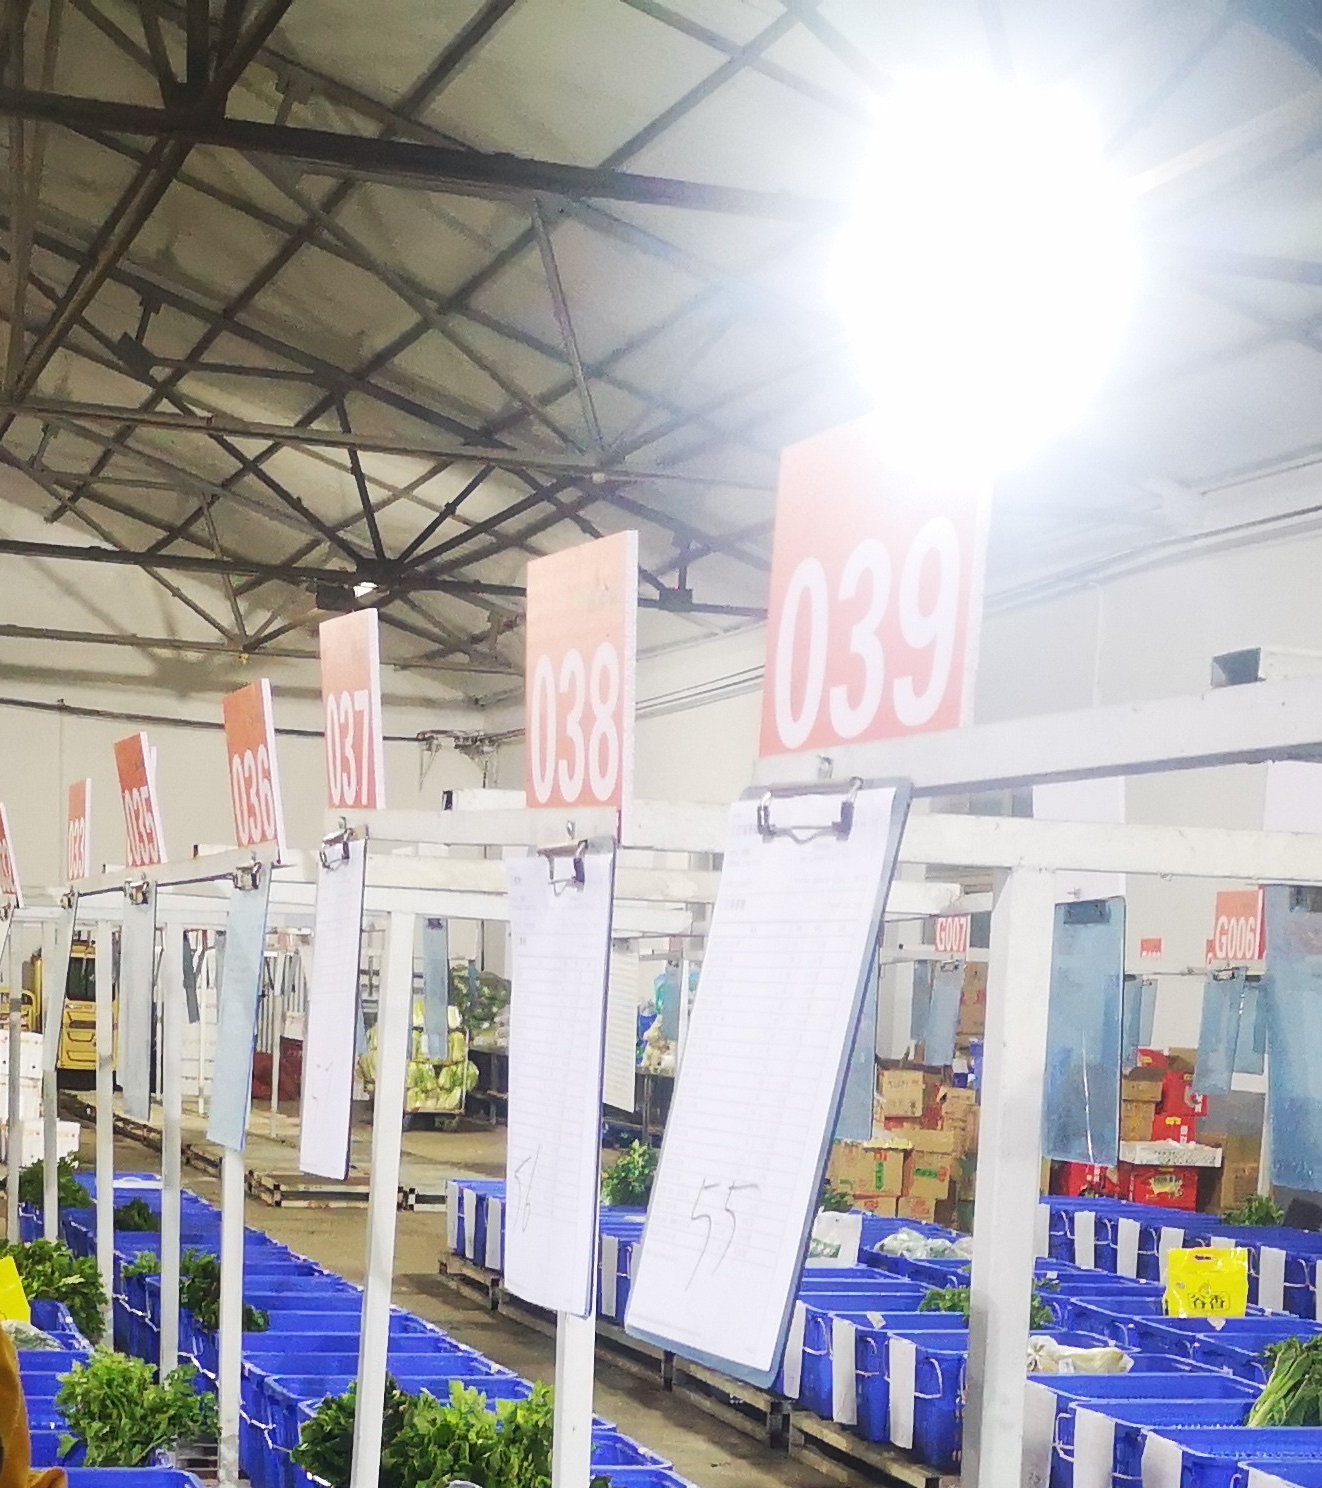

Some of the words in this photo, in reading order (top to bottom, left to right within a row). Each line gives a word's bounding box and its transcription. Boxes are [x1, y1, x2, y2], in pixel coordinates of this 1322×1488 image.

[776, 517, 961, 750] 039
[323, 690, 371, 807] 037
[530, 640, 621, 804] 038
[231, 744, 276, 847] 036
[936, 916, 967, 952] G007
[1215, 914, 1255, 961] G006
[685, 1177, 760, 1291] 55
